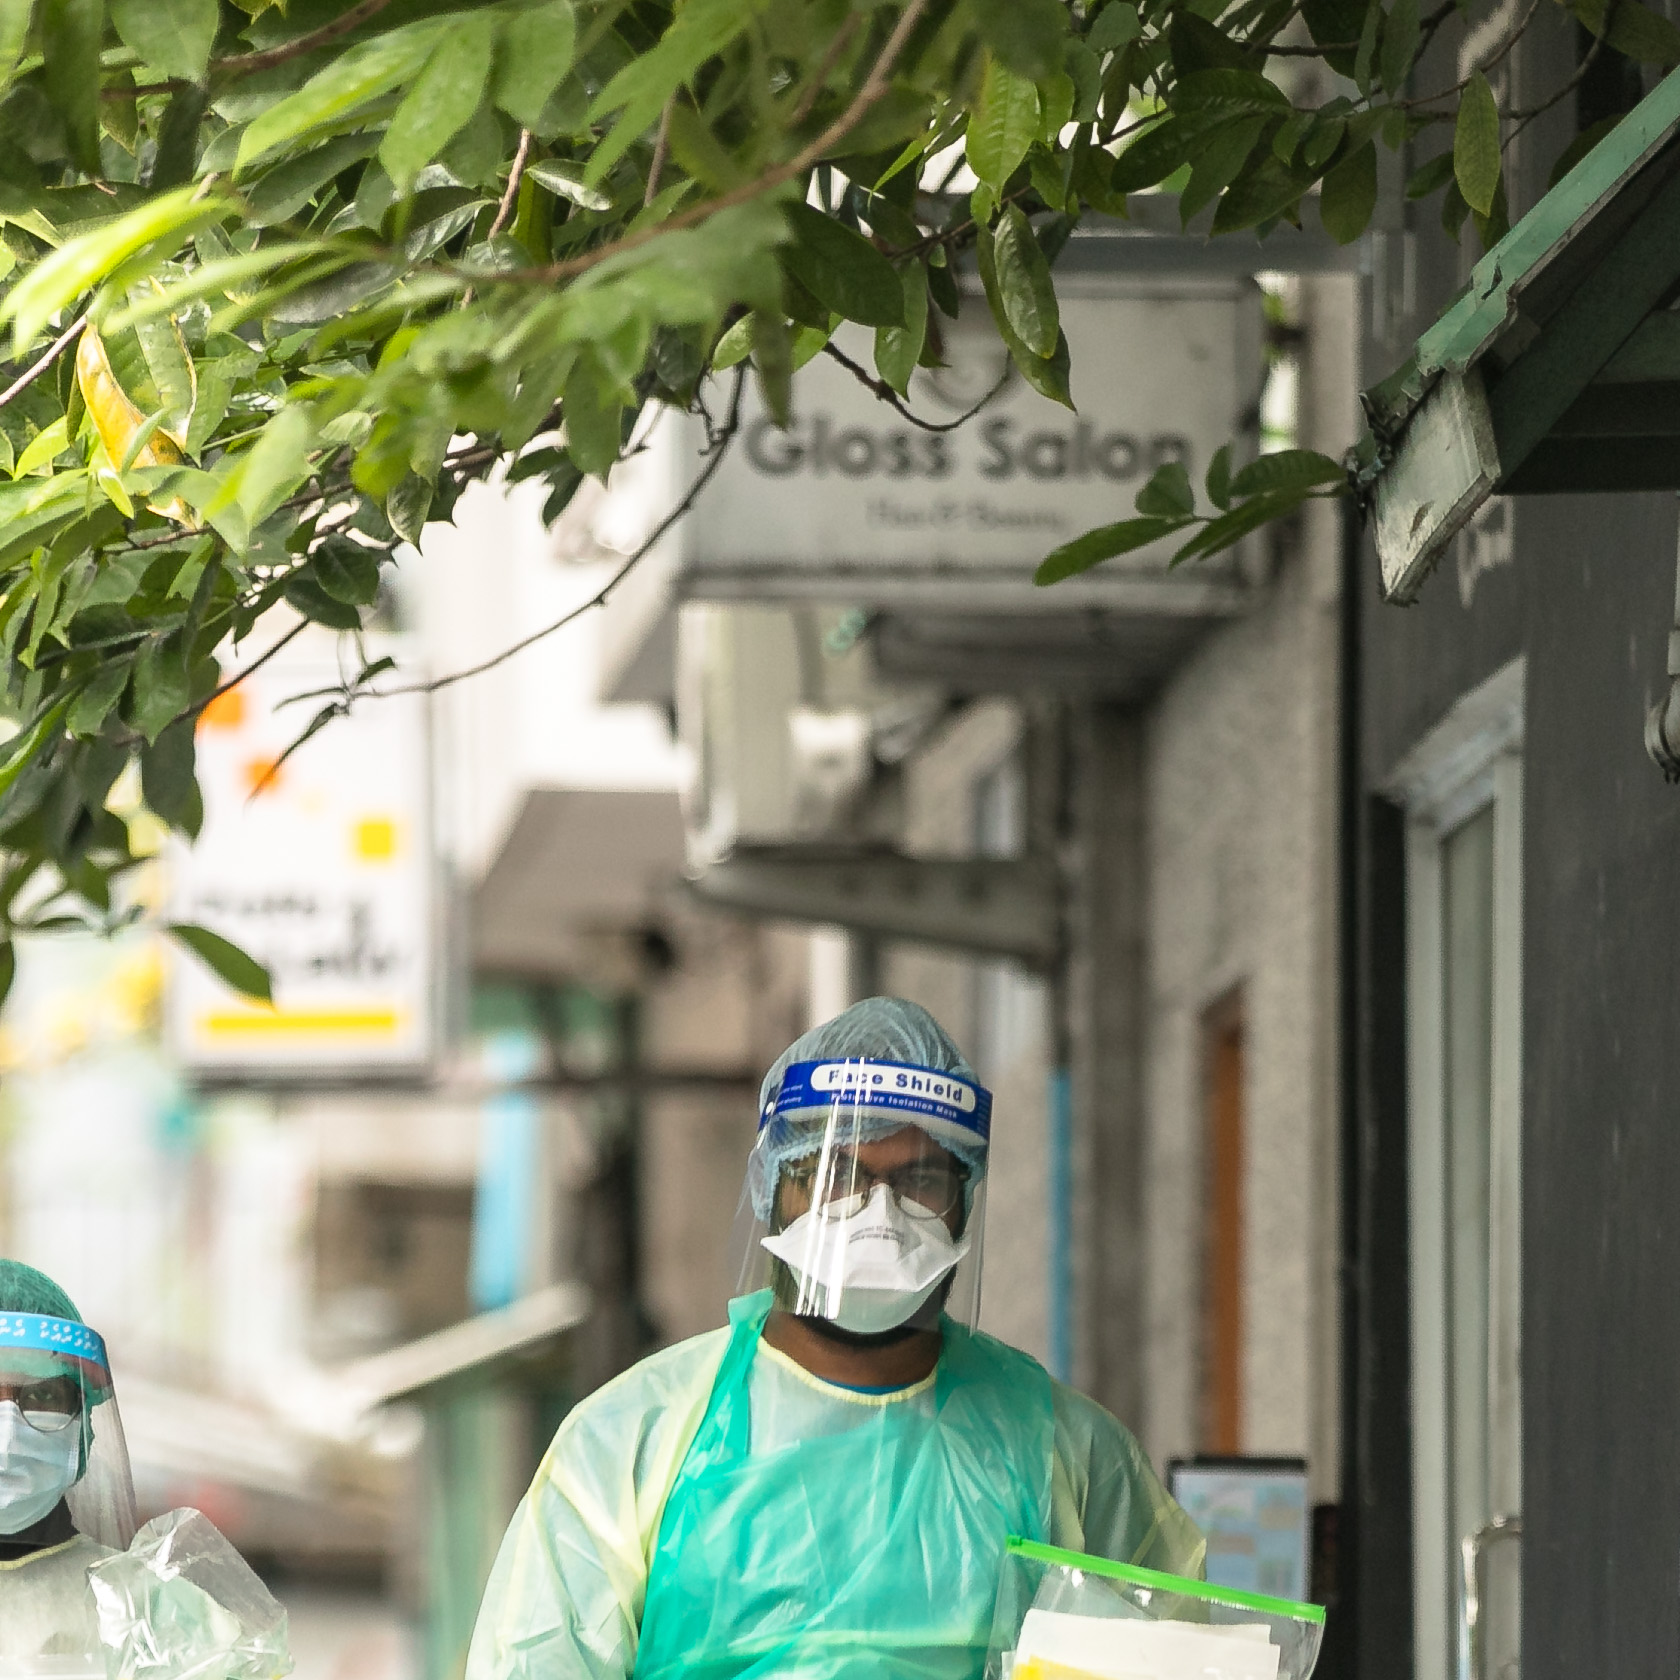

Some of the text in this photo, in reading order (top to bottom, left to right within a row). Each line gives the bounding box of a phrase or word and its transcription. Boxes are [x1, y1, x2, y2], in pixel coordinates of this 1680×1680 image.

[743, 411, 1193, 480] Gloss Salon
[830, 1092, 886, 1104] Potcive
[895, 1073, 963, 1102] Shield
